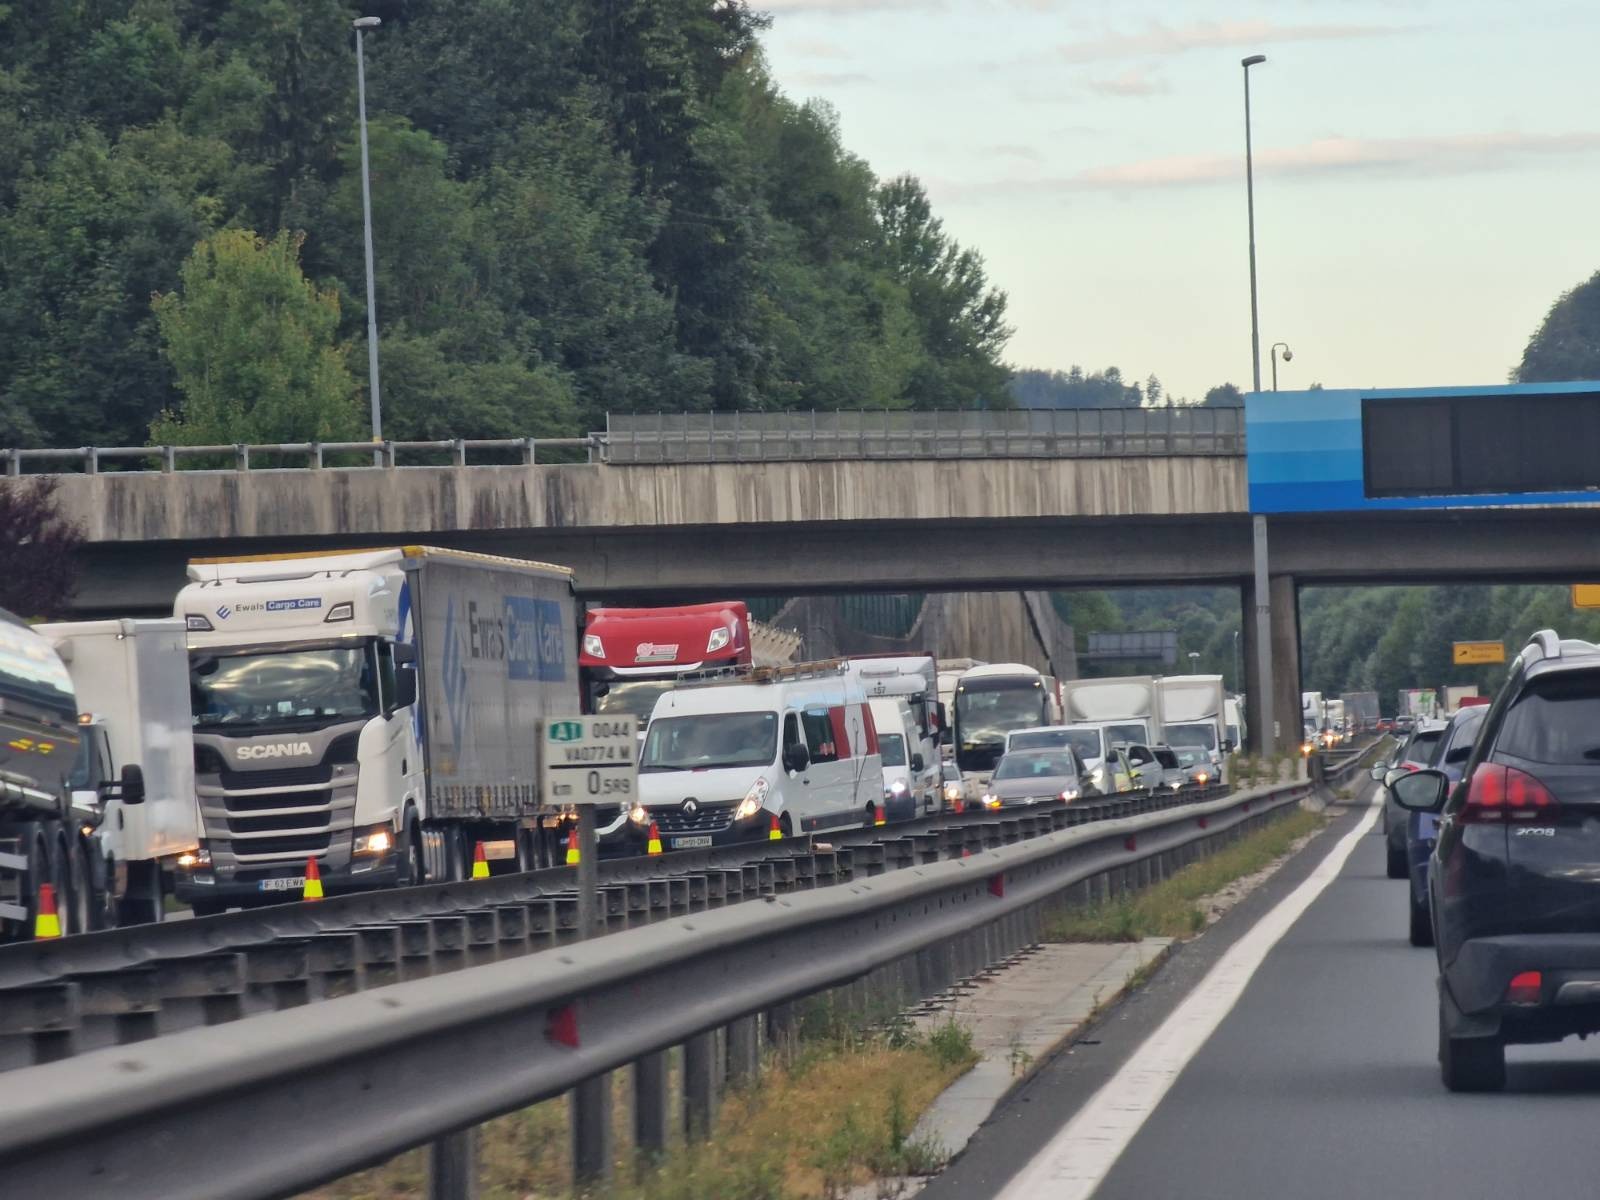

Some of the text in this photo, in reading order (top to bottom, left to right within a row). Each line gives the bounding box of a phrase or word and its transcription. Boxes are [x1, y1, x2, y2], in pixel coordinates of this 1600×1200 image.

[235, 598, 320, 612] Ewals Cargo Care
[555, 722, 629, 740] A1 0044
[236, 742, 312, 760] SCANIA
[553, 781, 572, 796] km
[1516, 826, 1556, 837] 2008
